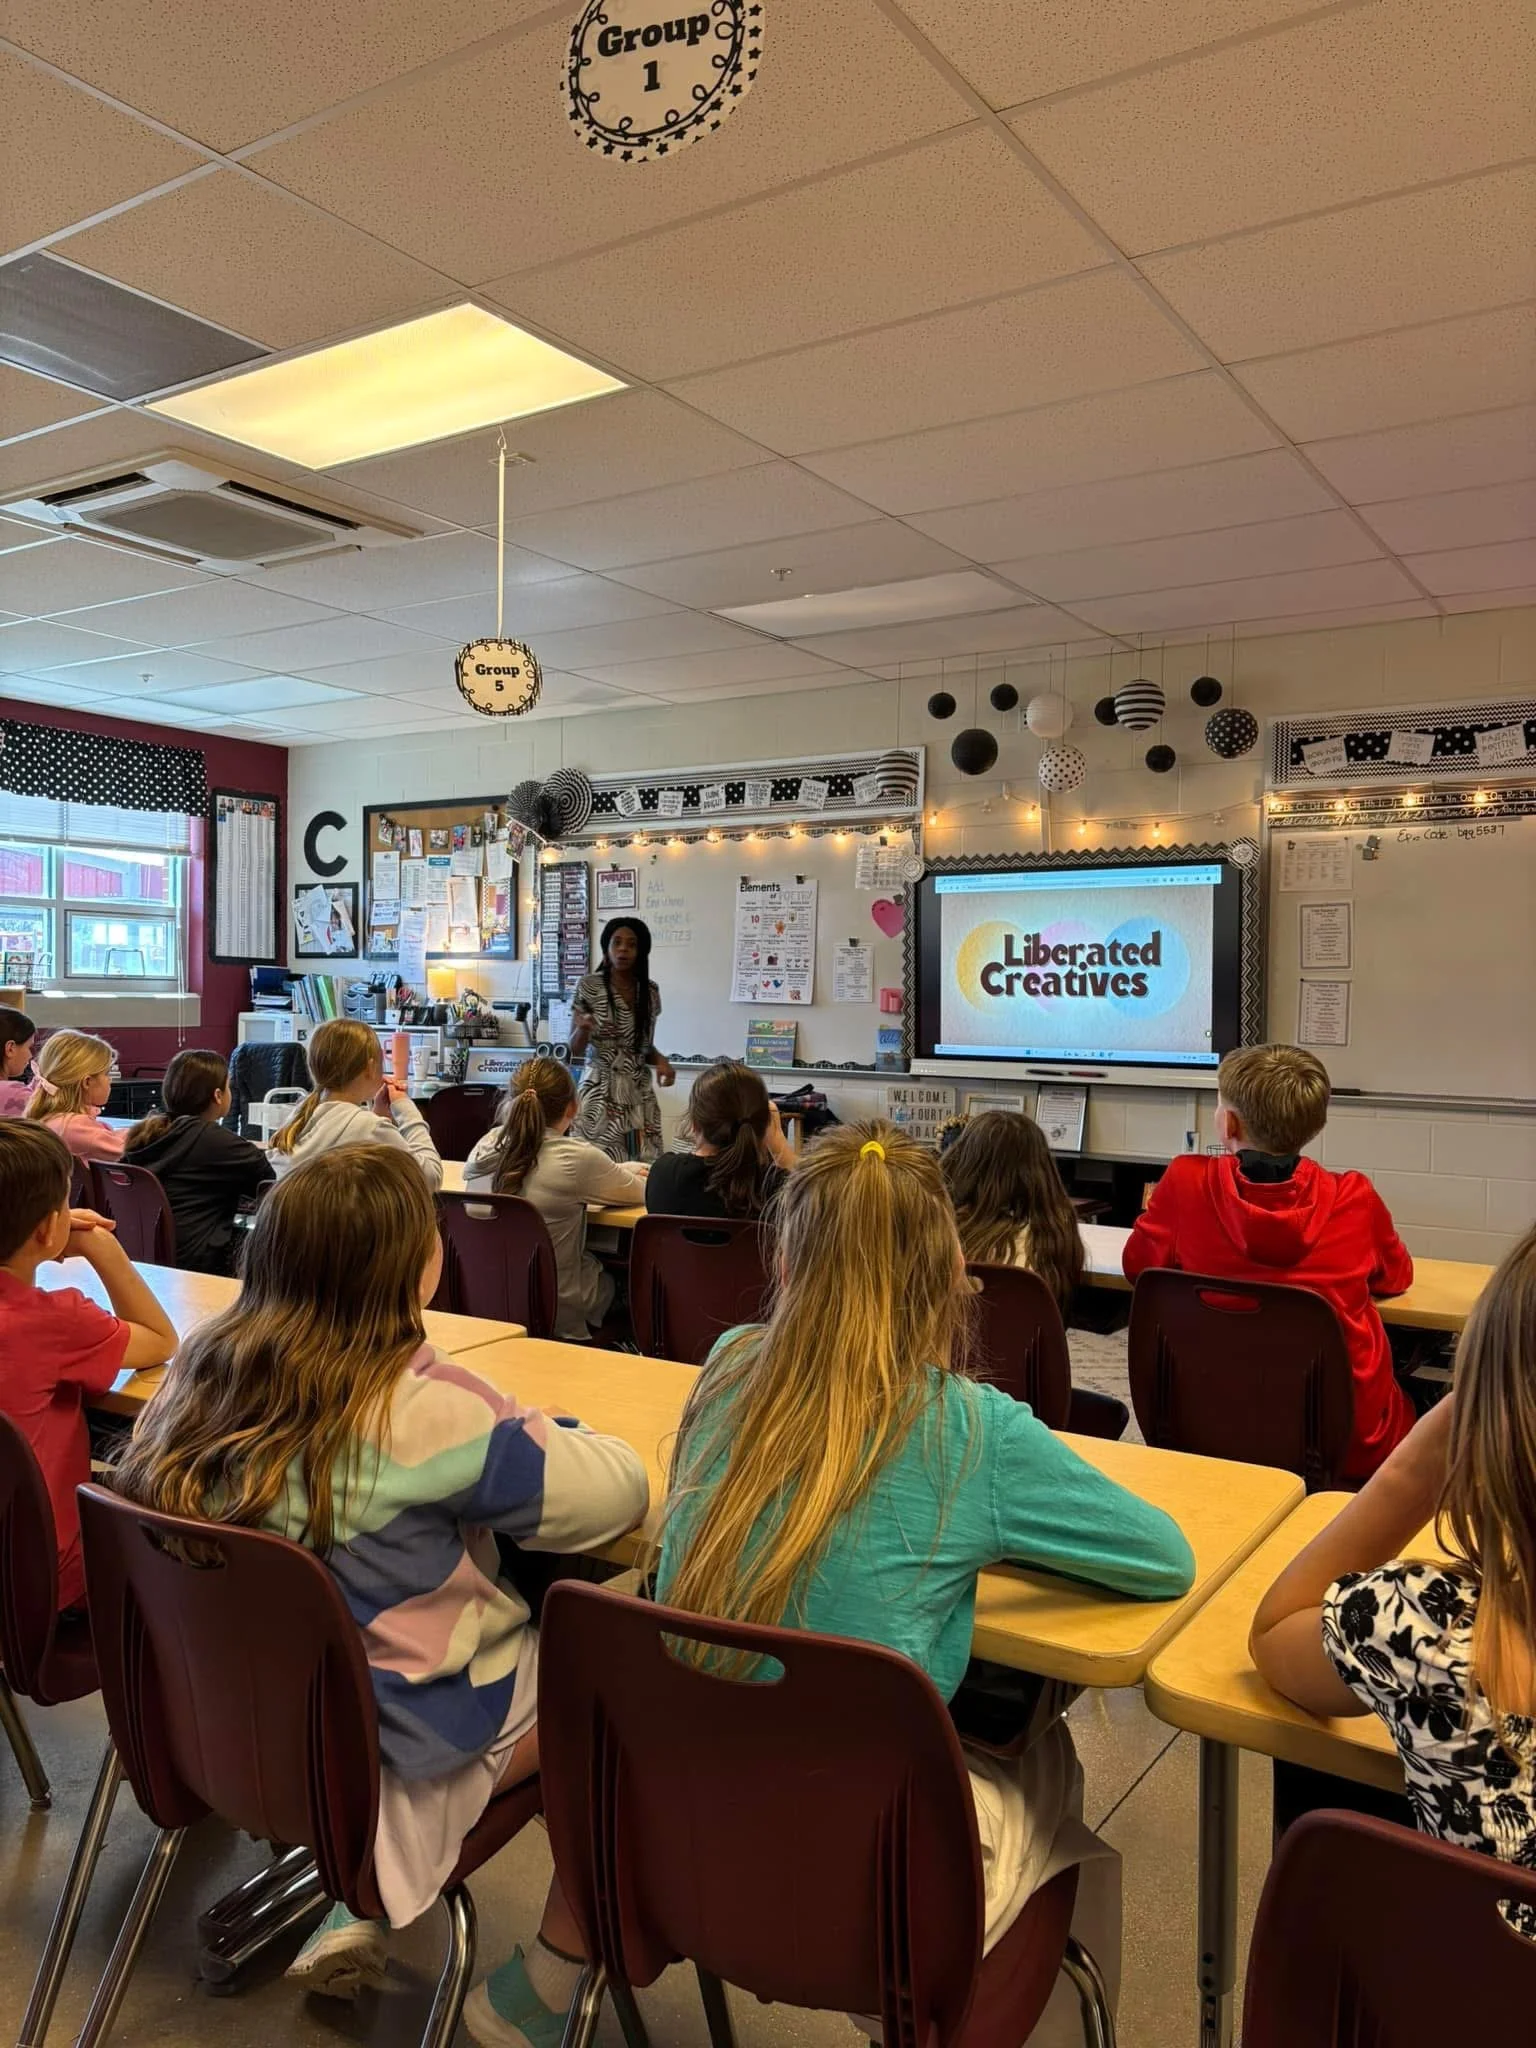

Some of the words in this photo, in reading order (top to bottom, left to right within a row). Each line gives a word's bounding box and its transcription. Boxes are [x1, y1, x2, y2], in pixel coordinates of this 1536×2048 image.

[597, 13, 710, 57] Group
[643, 60, 661, 92] 1
[475, 664, 520, 678] Group
[495, 680, 505, 692] 5
[304, 811, 348, 877] C
[740, 882, 781, 893] Elements
[780, 890, 813, 901] POETRY
[751, 915, 760, 923] 10
[1003, 930, 1162, 967] Liberated
[980, 961, 1150, 998] Creatives
[893, 1089, 947, 1104] WELCOME
